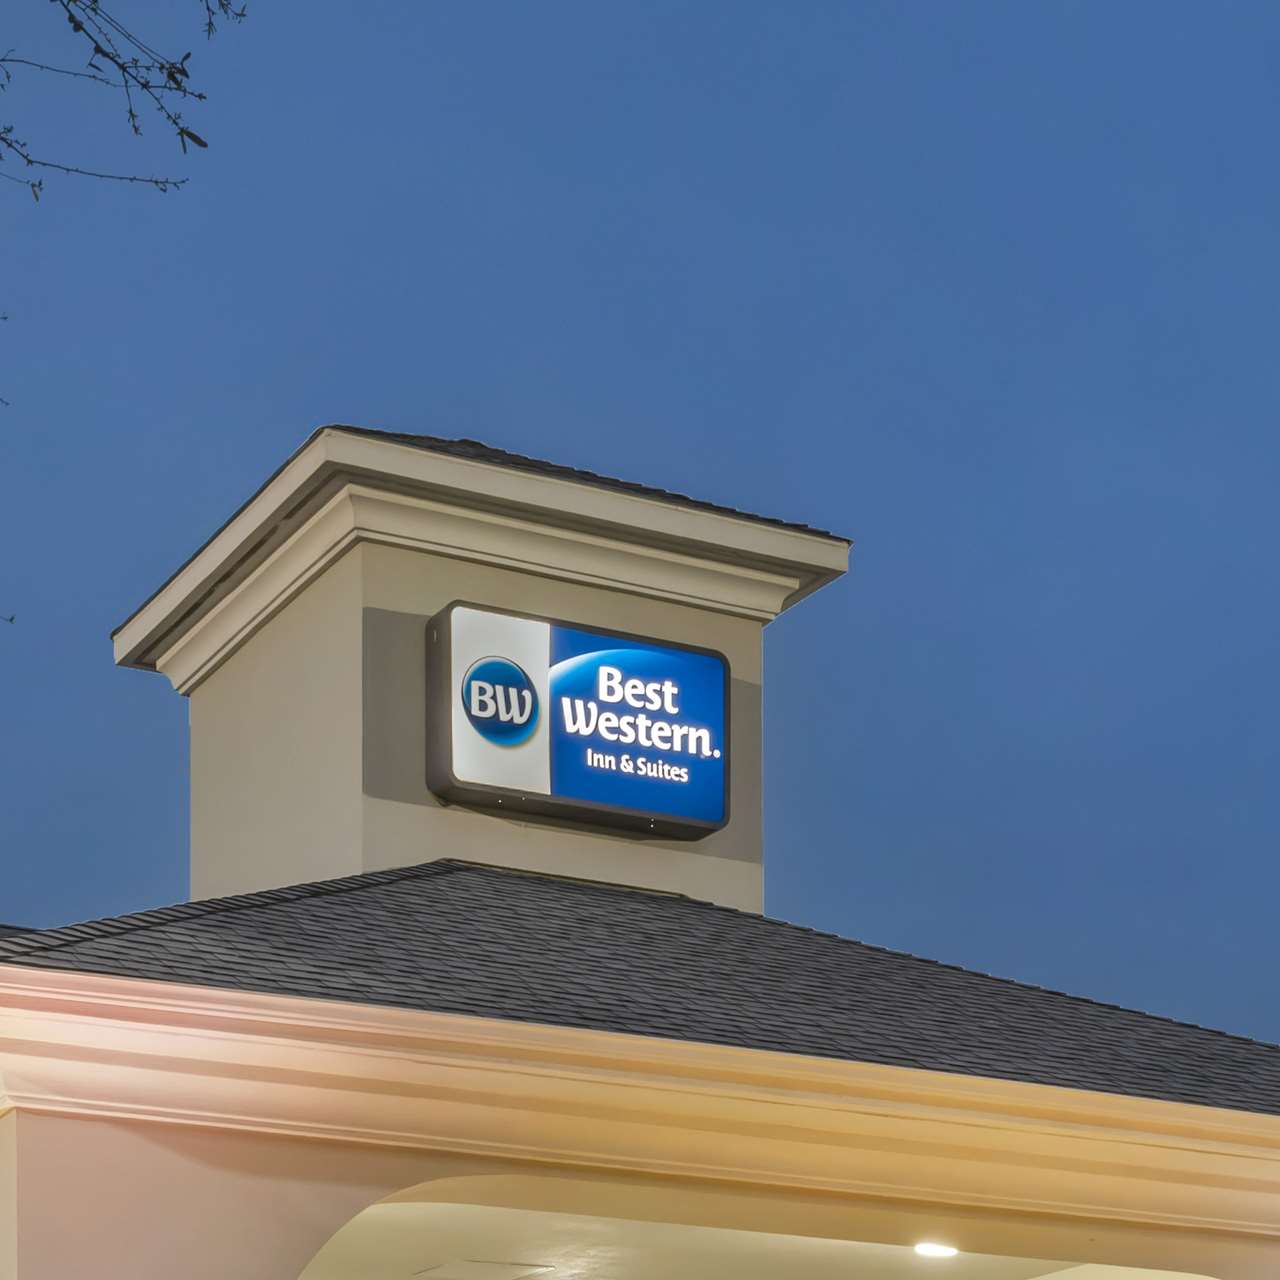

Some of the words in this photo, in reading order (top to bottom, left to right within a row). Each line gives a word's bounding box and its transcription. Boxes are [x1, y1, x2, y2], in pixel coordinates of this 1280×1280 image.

[471, 680, 532, 724] BW
[598, 665, 679, 714] Best
[586, 748, 616, 770] Inn
[620, 754, 634, 773] &
[637, 757, 689, 782] Suites
